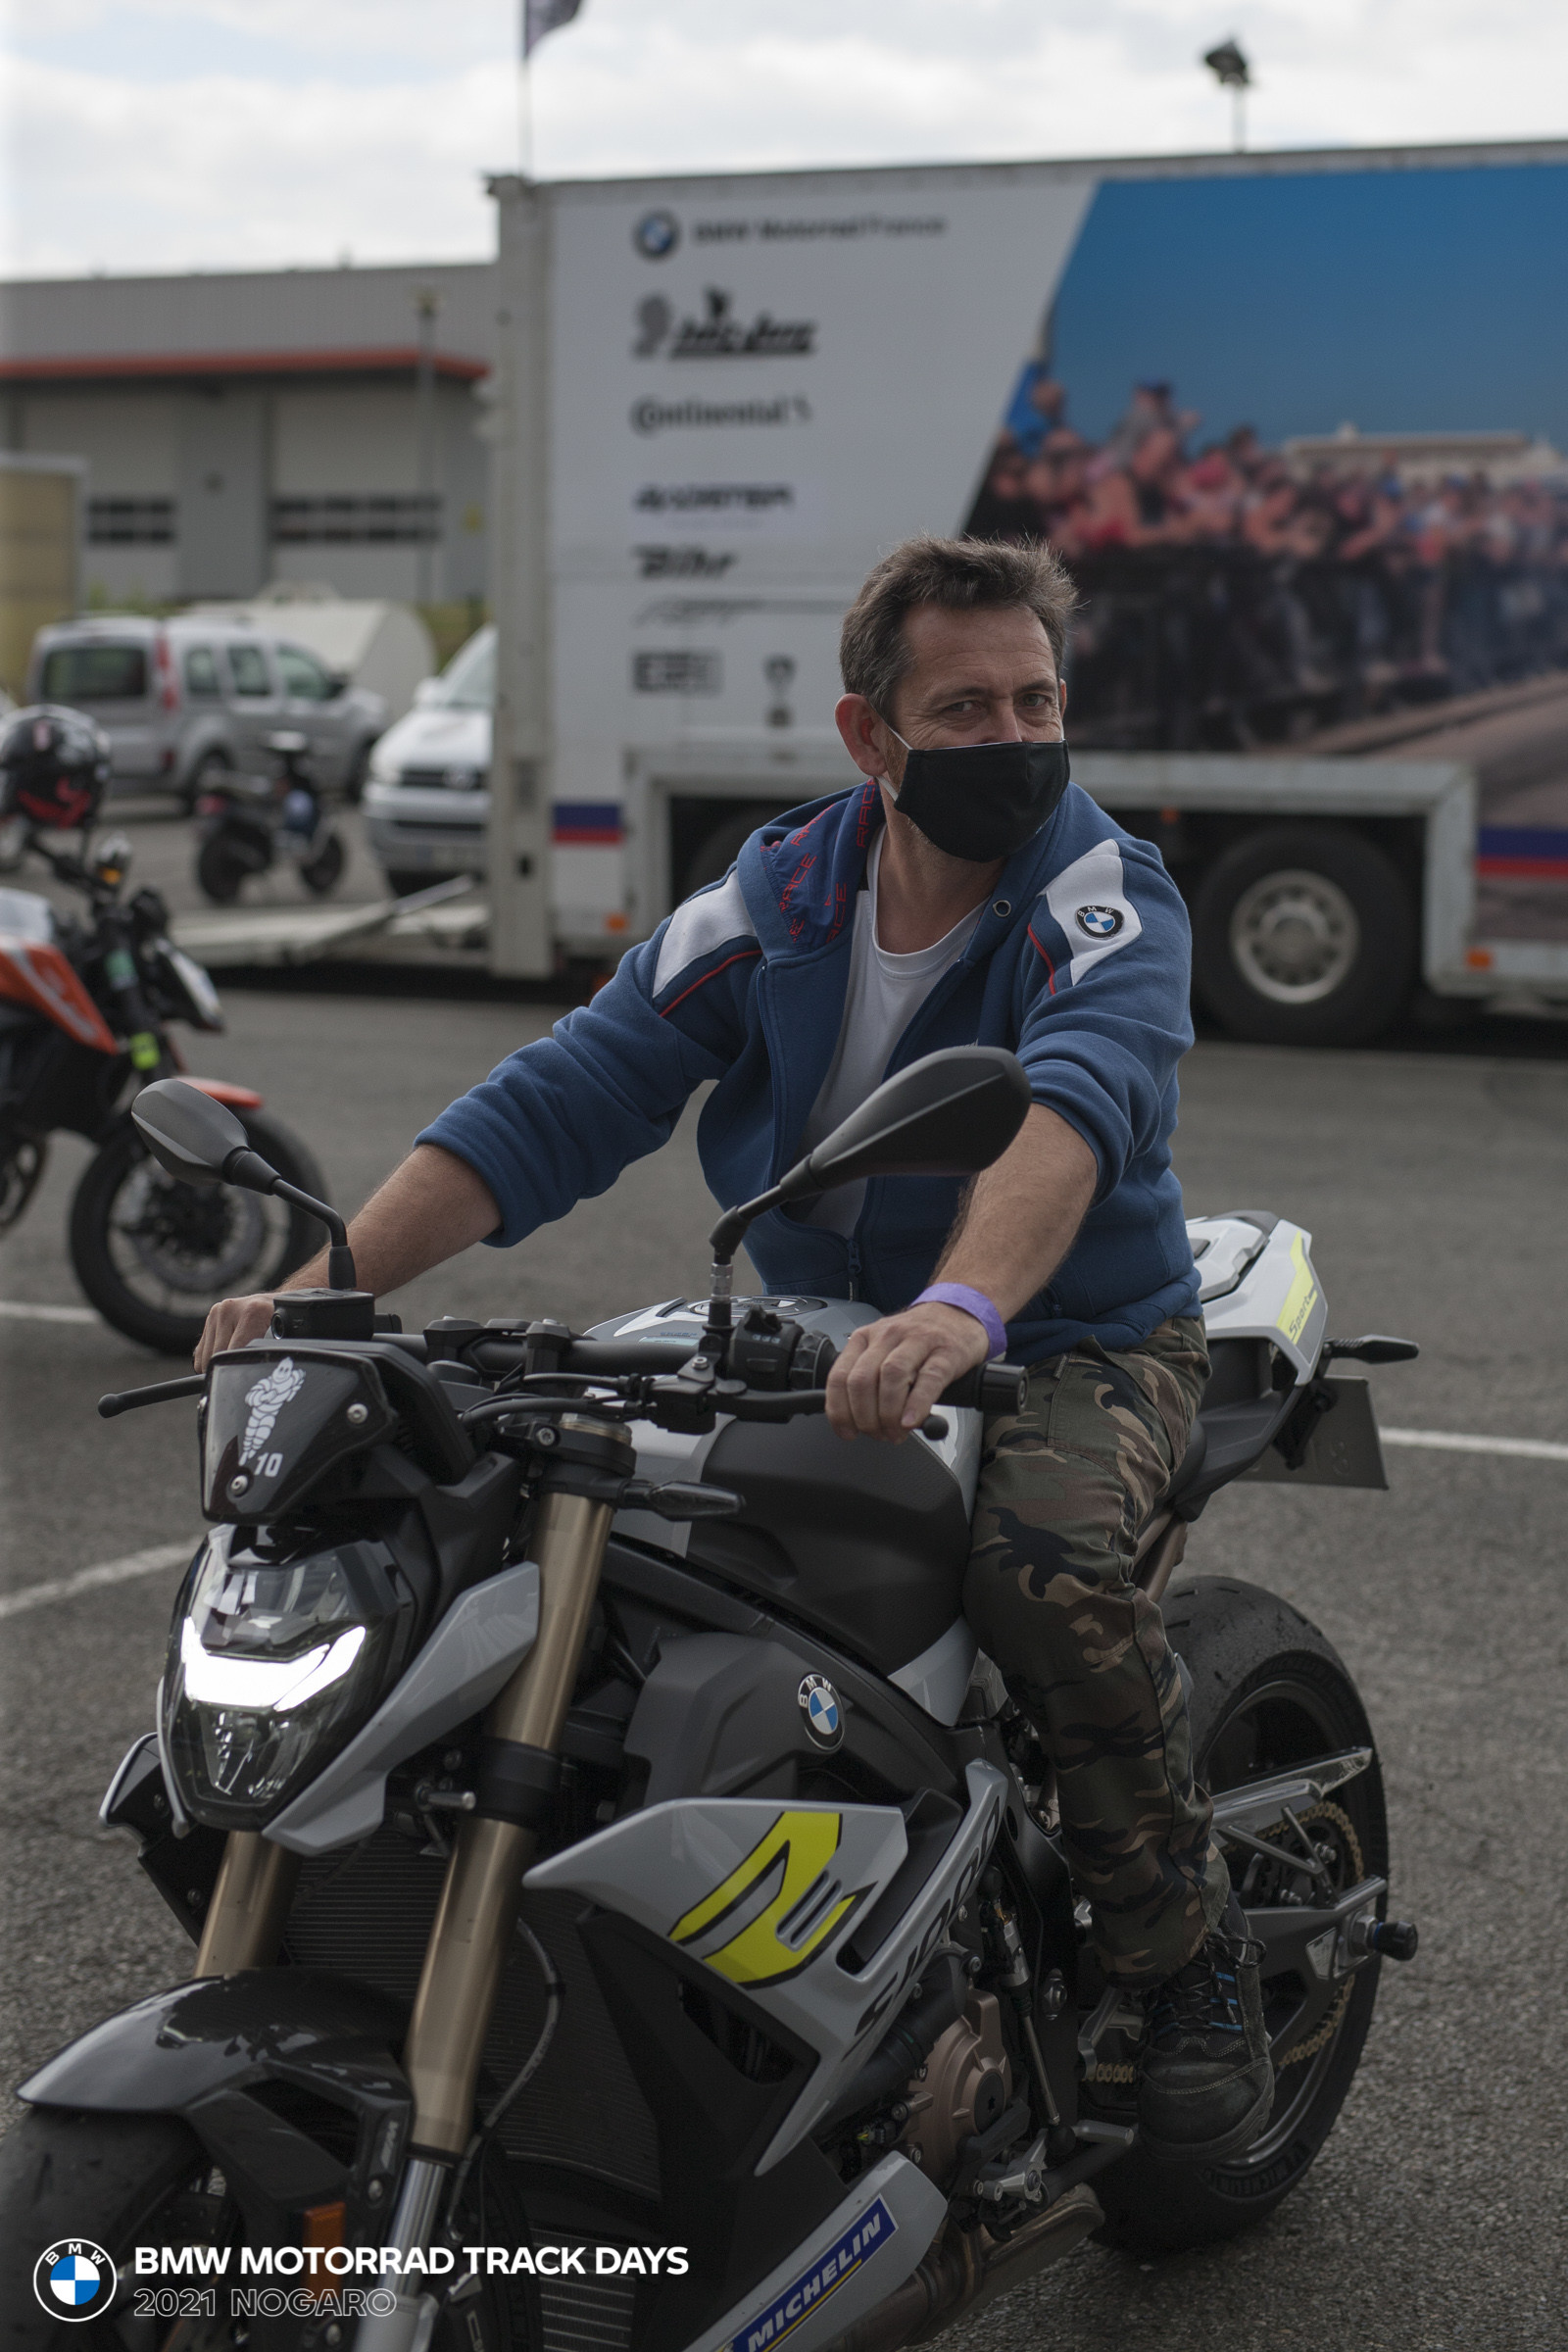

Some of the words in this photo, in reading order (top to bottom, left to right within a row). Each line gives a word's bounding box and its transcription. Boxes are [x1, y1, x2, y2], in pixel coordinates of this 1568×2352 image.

[1289, 1287, 1314, 1341] Sport
[254, 1451, 283, 1478] 10
[747, 2213, 882, 2352] MICHELIN
